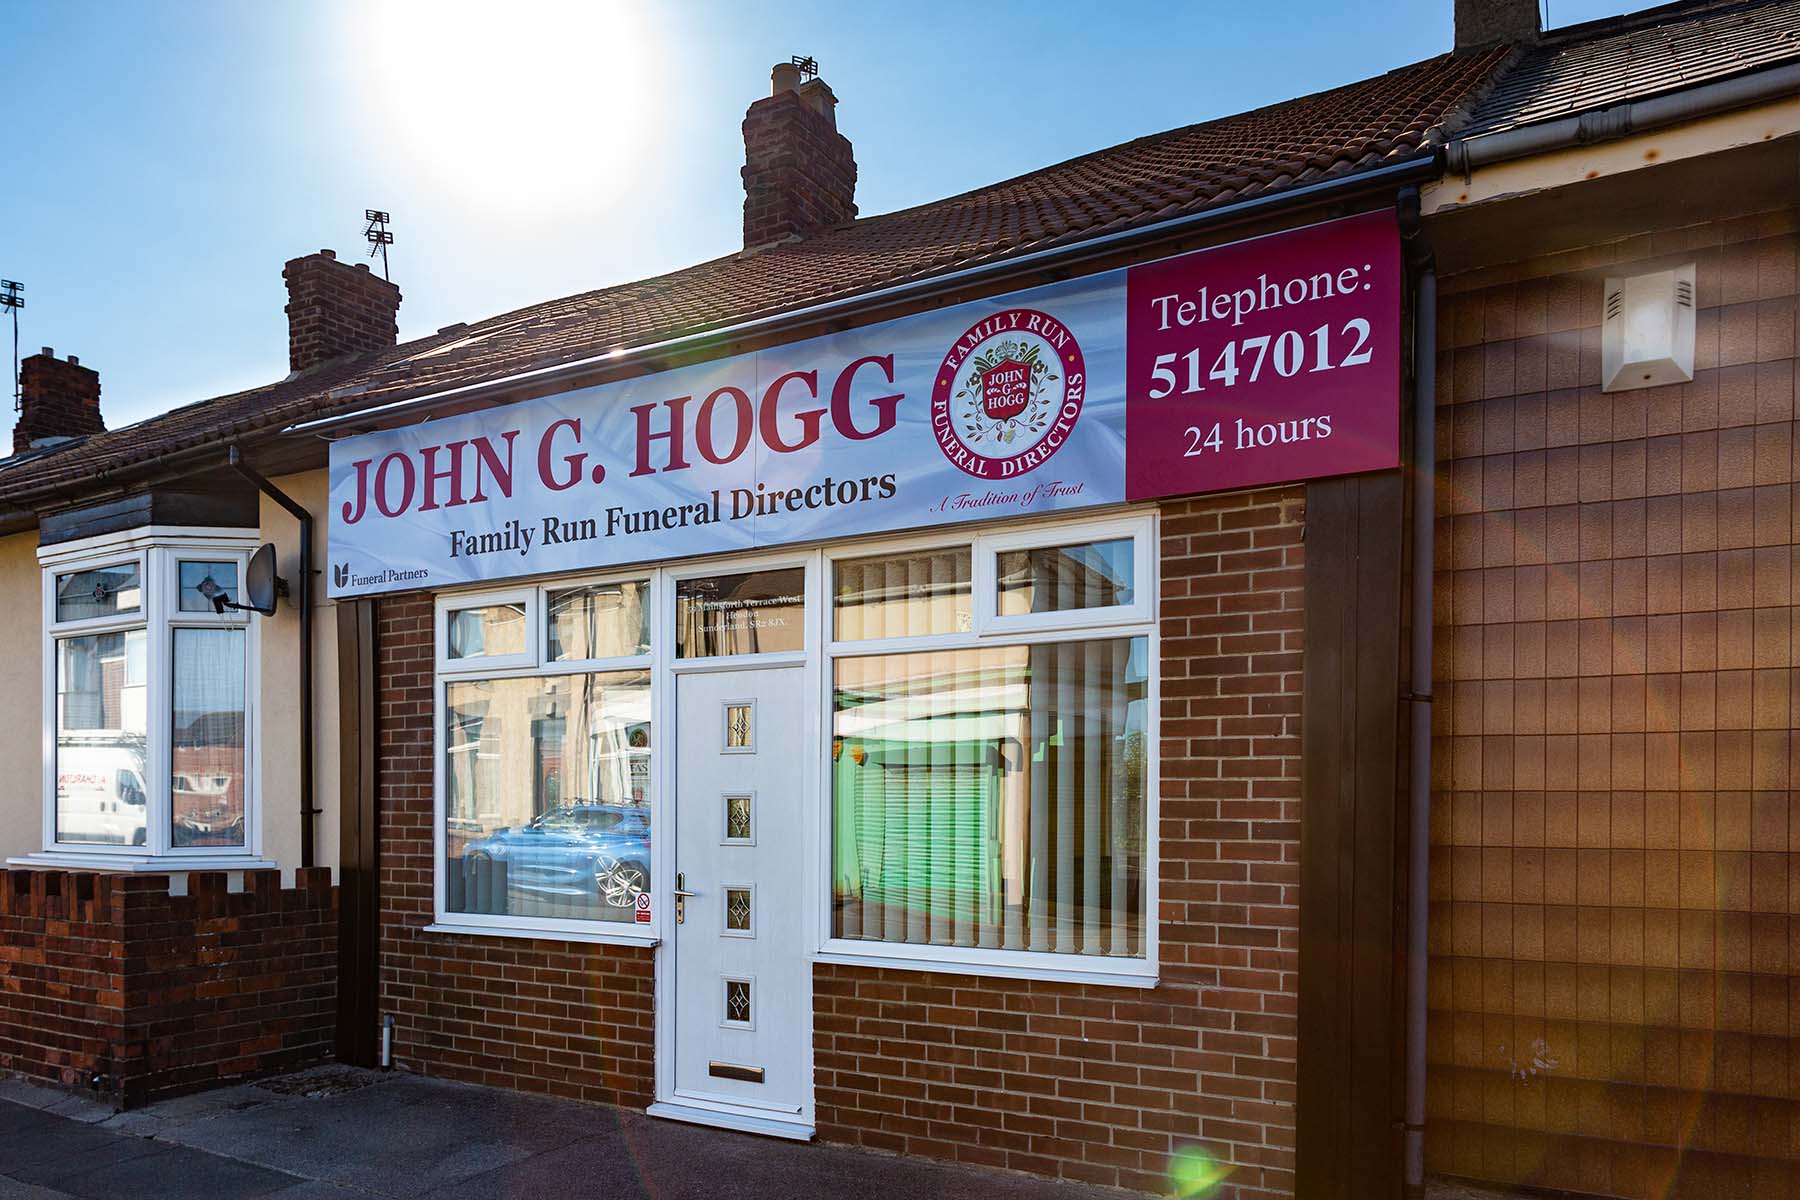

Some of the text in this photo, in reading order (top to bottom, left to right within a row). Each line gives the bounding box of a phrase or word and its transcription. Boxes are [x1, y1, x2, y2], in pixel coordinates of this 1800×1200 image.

[1151, 264, 1371, 331] Telephone:
[945, 312, 1071, 371] FAMILY RUN
[1149, 317, 1373, 399] 5147012
[988, 368, 1024, 387] JOHN
[1002, 383, 1012, 395] G
[988, 393, 1025, 410] HOGG
[342, 353, 905, 525] JOHN G. HOGG
[934, 373, 1083, 477] FUNERAL DIRECTORS
[1183, 413, 1332, 457] 24 hours
[449, 472, 896, 558] Family Run Funeral Directors
[929, 481, 1084, 513] A Tradition of Trust
[352, 568, 429, 586] Funeral Partners
[743, 598, 777, 608] Terrace
[779, 595, 801, 604] West
